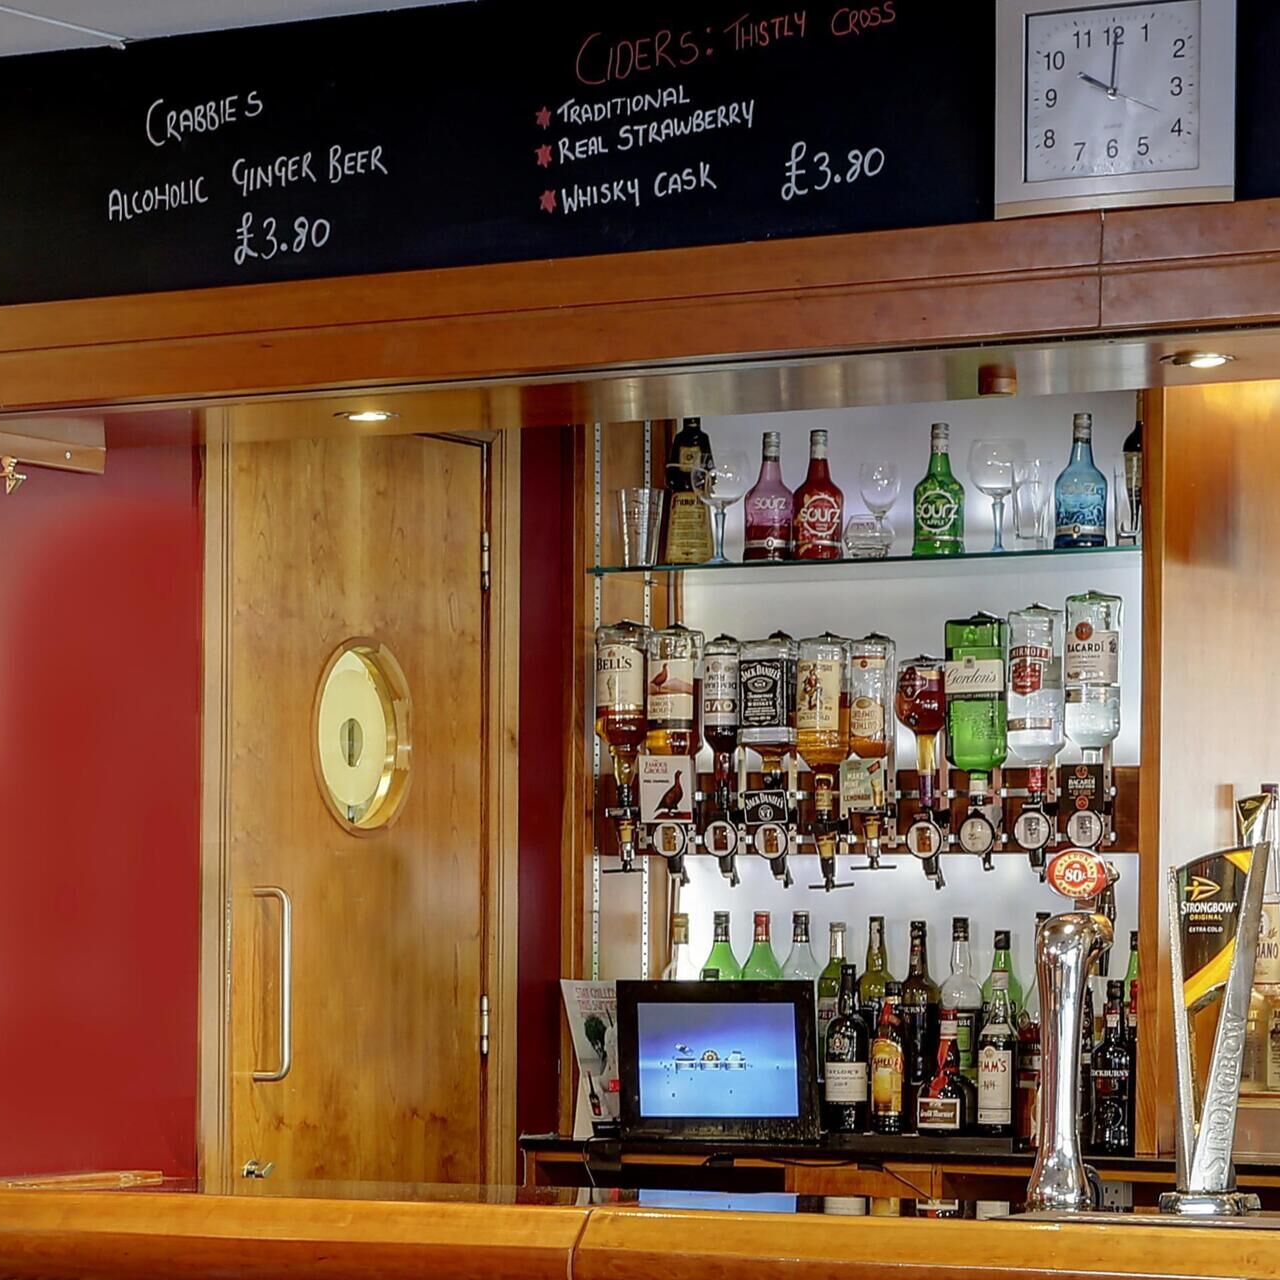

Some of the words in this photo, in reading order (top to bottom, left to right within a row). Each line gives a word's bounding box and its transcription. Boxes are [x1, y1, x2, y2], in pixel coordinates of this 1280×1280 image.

[576, 26, 714, 85] CIDERS:
[723, 10, 807, 50] THISTLY
[831, 1, 896, 35] CROSS
[1072, 28, 1092, 49] 11
[1103, 25, 1125, 46] 12
[1140, 23, 1149, 42] 1
[1172, 38, 1186, 58] 2
[1043, 50, 1066, 71] 10
[1170, 76, 1184, 97] 3
[557, 85, 690, 125] TRADITIONAL
[1045, 88, 1058, 108] 9
[558, 136, 609, 164] REAL
[617, 99, 754, 151] STRAWBERRY
[1170, 117, 1184, 137] 4
[1043, 129, 1056, 149] 8
[1106, 138, 1119, 159] 6
[1136, 136, 1150, 156] 5
[1073, 142, 1087, 162] 7
[781, 140, 885, 200] £3.80
[108, 177, 208, 222] ALCOHOLIC
[232, 152, 316, 197] GINGER
[329, 145, 388, 184] BEER
[561, 178, 640, 214] WHISKY
[654, 161, 717, 197] CASK
[234, 212, 331, 265] £3.80
[596, 655, 632, 672] BELL'S
[947, 666, 997, 686] Gordon's
[1180, 900, 1238, 915] STRONGBOW
[1189, 913, 1223, 921] ORIGINAL
[1188, 926, 1207, 934] EXTRA
[1207, 926, 1224, 934] COLD
[1199, 1012, 1247, 1178] STRONGBOW
